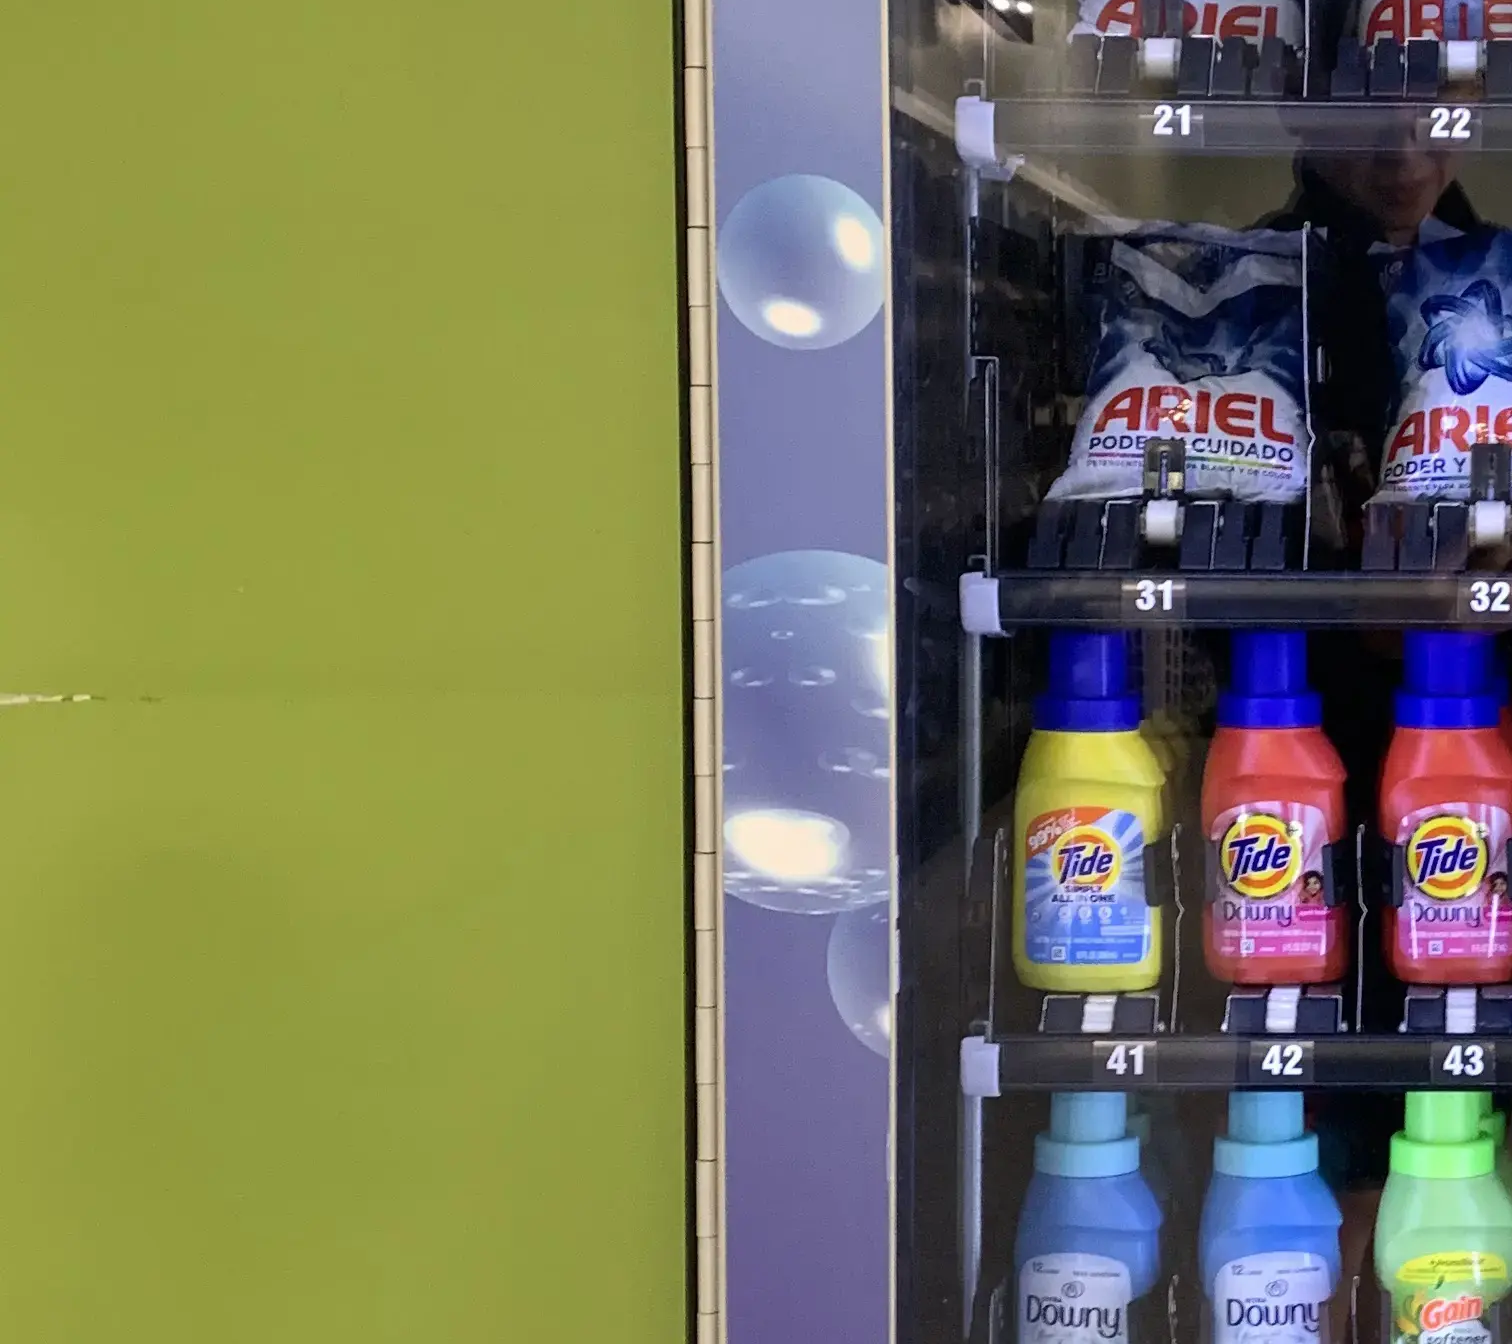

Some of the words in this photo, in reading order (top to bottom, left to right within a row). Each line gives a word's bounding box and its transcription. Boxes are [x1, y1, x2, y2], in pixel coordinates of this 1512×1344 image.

[1153, 104, 1191, 136] 21
[1430, 107, 1471, 138] 22
[1092, 386, 1295, 445] ARIEL
[1089, 436, 1147, 451] PODE
[1191, 436, 1294, 462] CUIDADO
[1383, 457, 1447, 480] PODER
[1453, 457, 1467, 473] Y
[1135, 580, 1172, 610] 31
[1470, 581, 1511, 612] 32
[1058, 844, 1114, 886] Tide
[1228, 836, 1292, 883] Tide
[1415, 837, 1480, 884] Tide
[1051, 894, 1074, 903] ALL
[1224, 900, 1293, 928] Downy
[1413, 902, 1482, 929] Downy
[1106, 1045, 1144, 1076] 41
[1262, 1044, 1303, 1075] 42
[1443, 1044, 1484, 1076] 43
[1026, 1295, 1123, 1339] Downy
[1226, 1297, 1321, 1333] Downy
[1420, 1295, 1483, 1332] Gain
